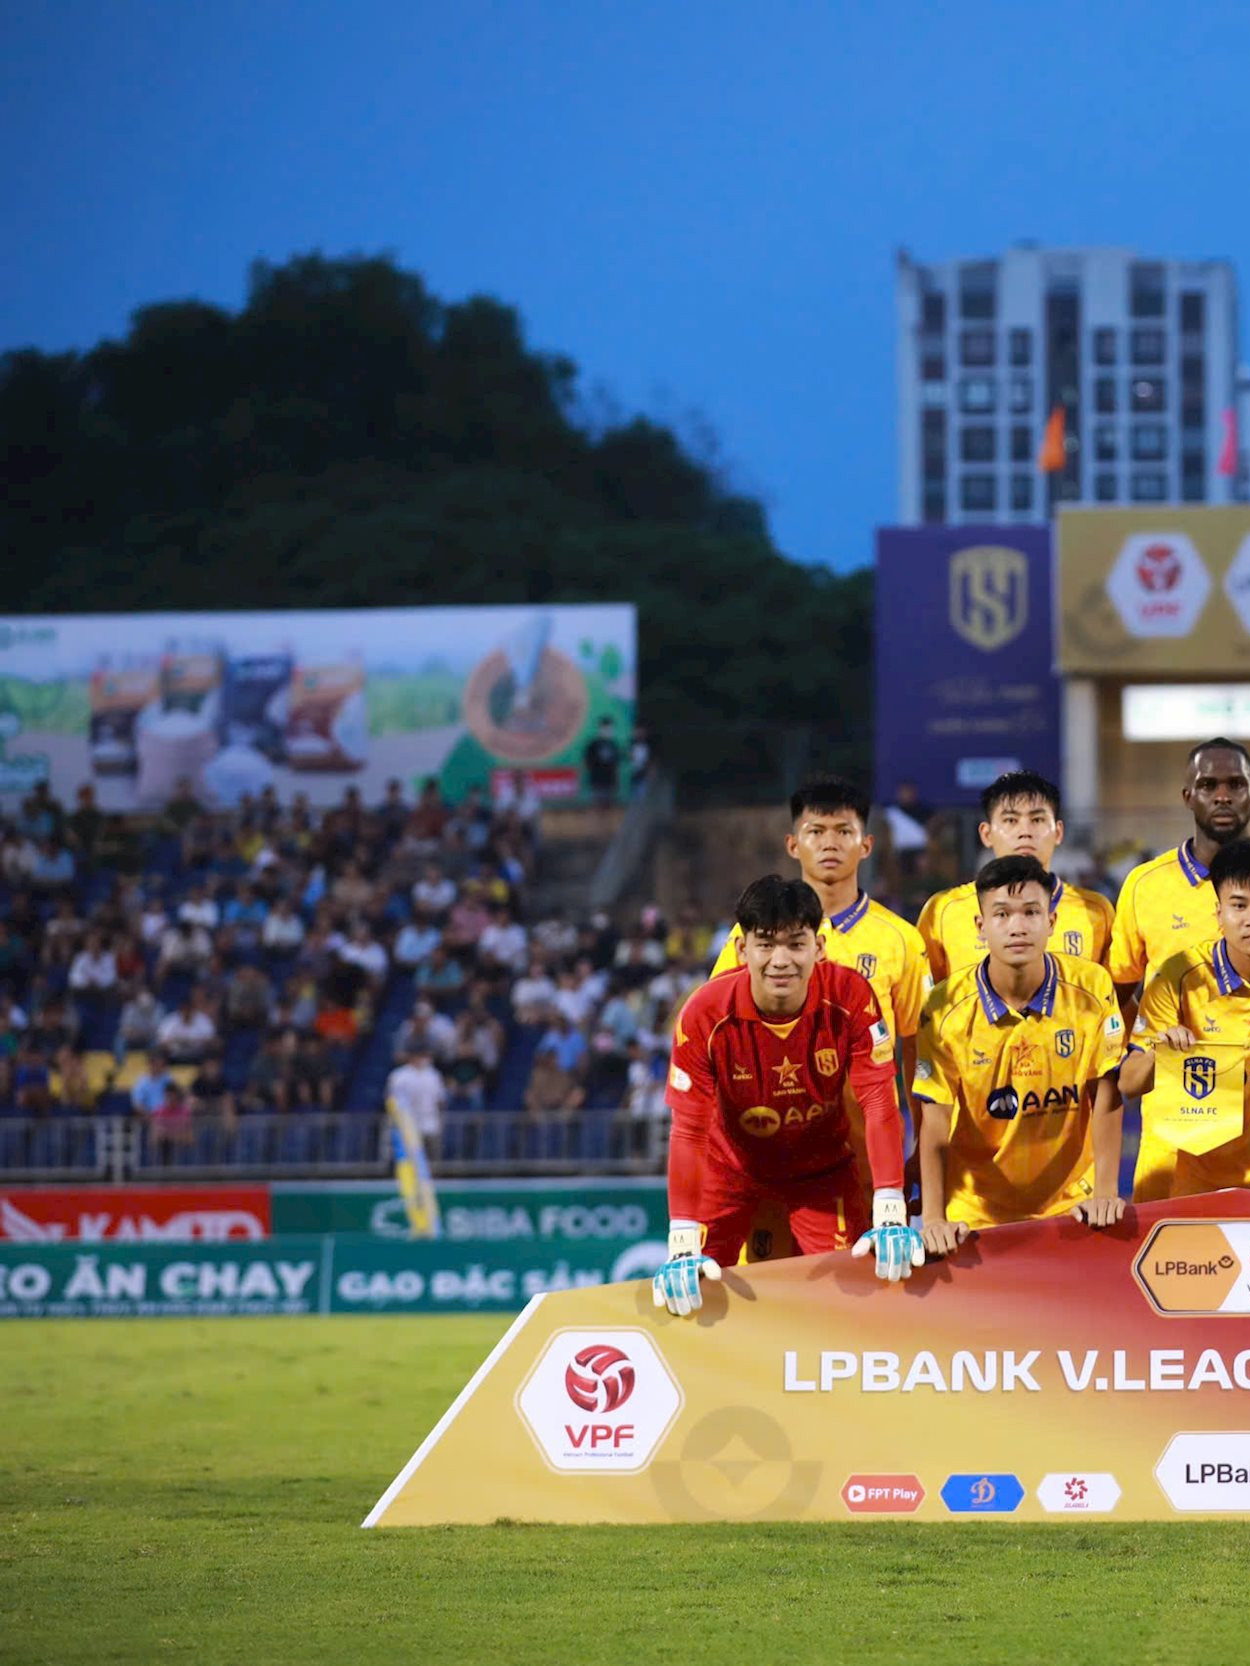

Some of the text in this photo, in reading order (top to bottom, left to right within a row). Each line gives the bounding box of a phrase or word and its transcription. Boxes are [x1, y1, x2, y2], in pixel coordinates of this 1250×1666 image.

[1022, 1084, 1079, 1111] AAN
[1180, 1106, 1217, 1116] SLNA FC
[446, 1204, 648, 1241] SIBA FOOD
[63, 1254, 147, 1300] ĂN
[159, 1261, 315, 1300] CHAY
[1155, 1260, 1218, 1276] LPBank
[783, 1350, 1042, 1392] LPBANK
[564, 1424, 634, 1448] VPF
[867, 1488, 918, 1501] FPT Play
